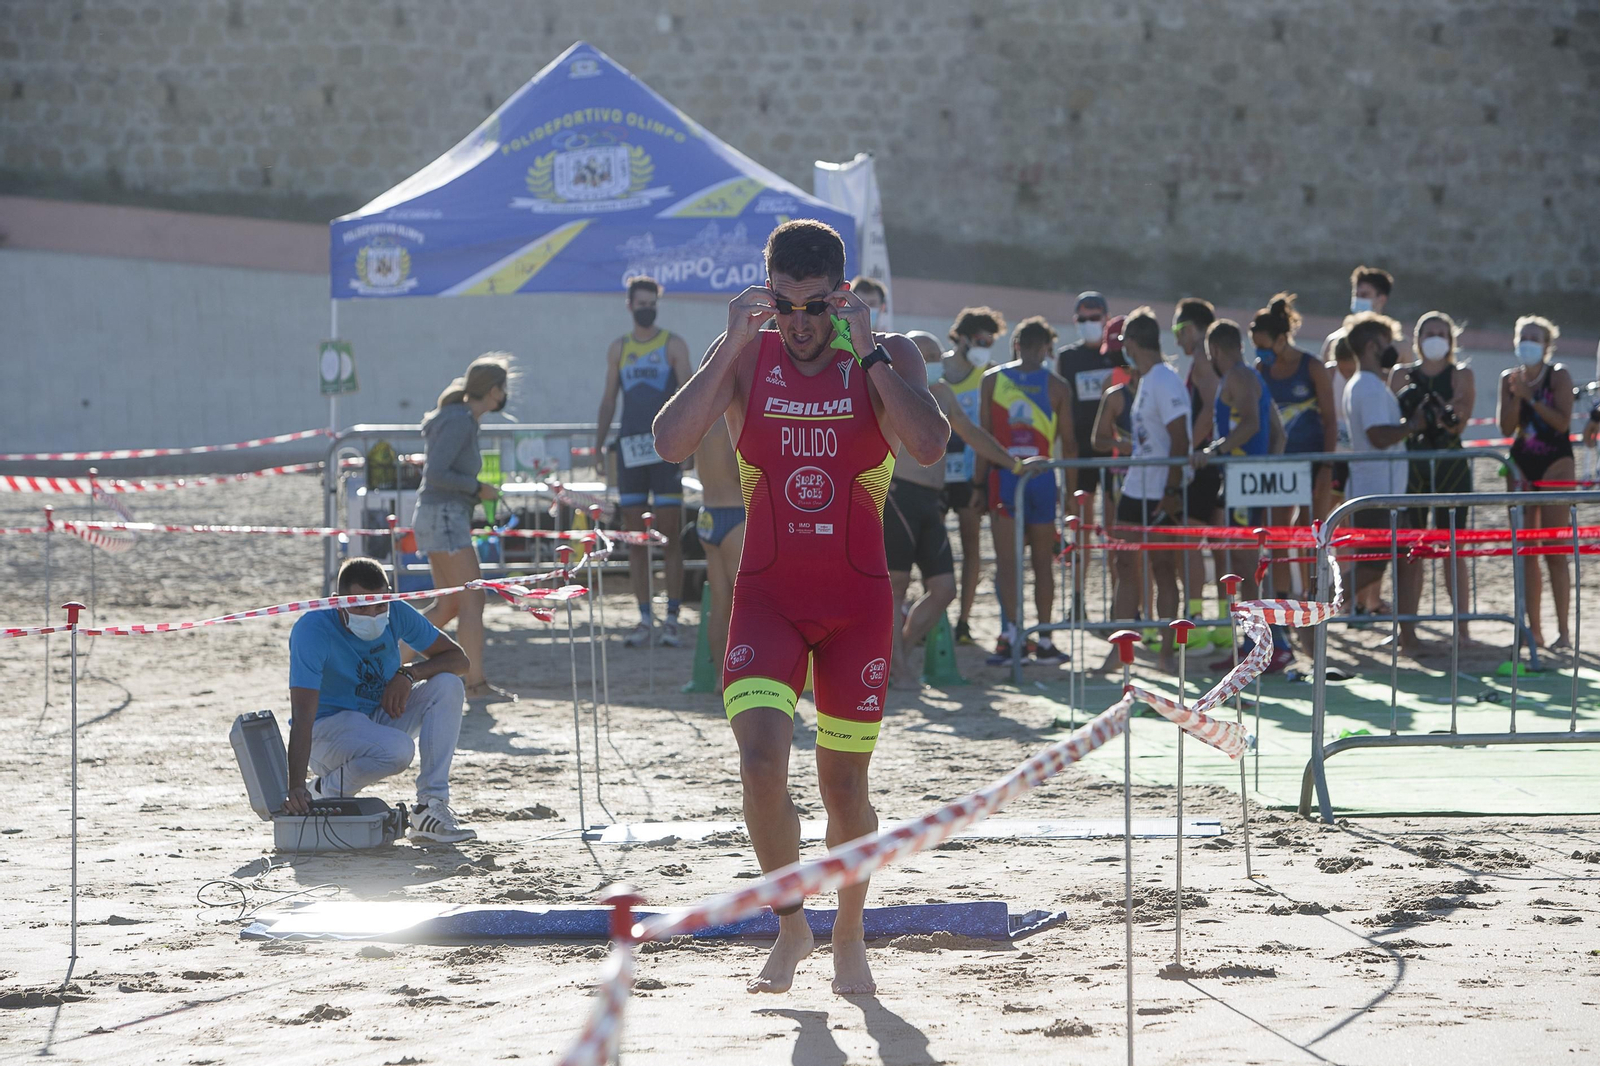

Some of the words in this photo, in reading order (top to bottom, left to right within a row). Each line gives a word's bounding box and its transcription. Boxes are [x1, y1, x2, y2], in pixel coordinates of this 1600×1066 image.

[502, 108, 623, 155] POLIDEPORTIVO
[626, 112, 686, 143] OLIMPO
[710, 260, 766, 289] CADI
[765, 397, 852, 416] ISBILYA
[781, 427, 838, 457] PULIDO
